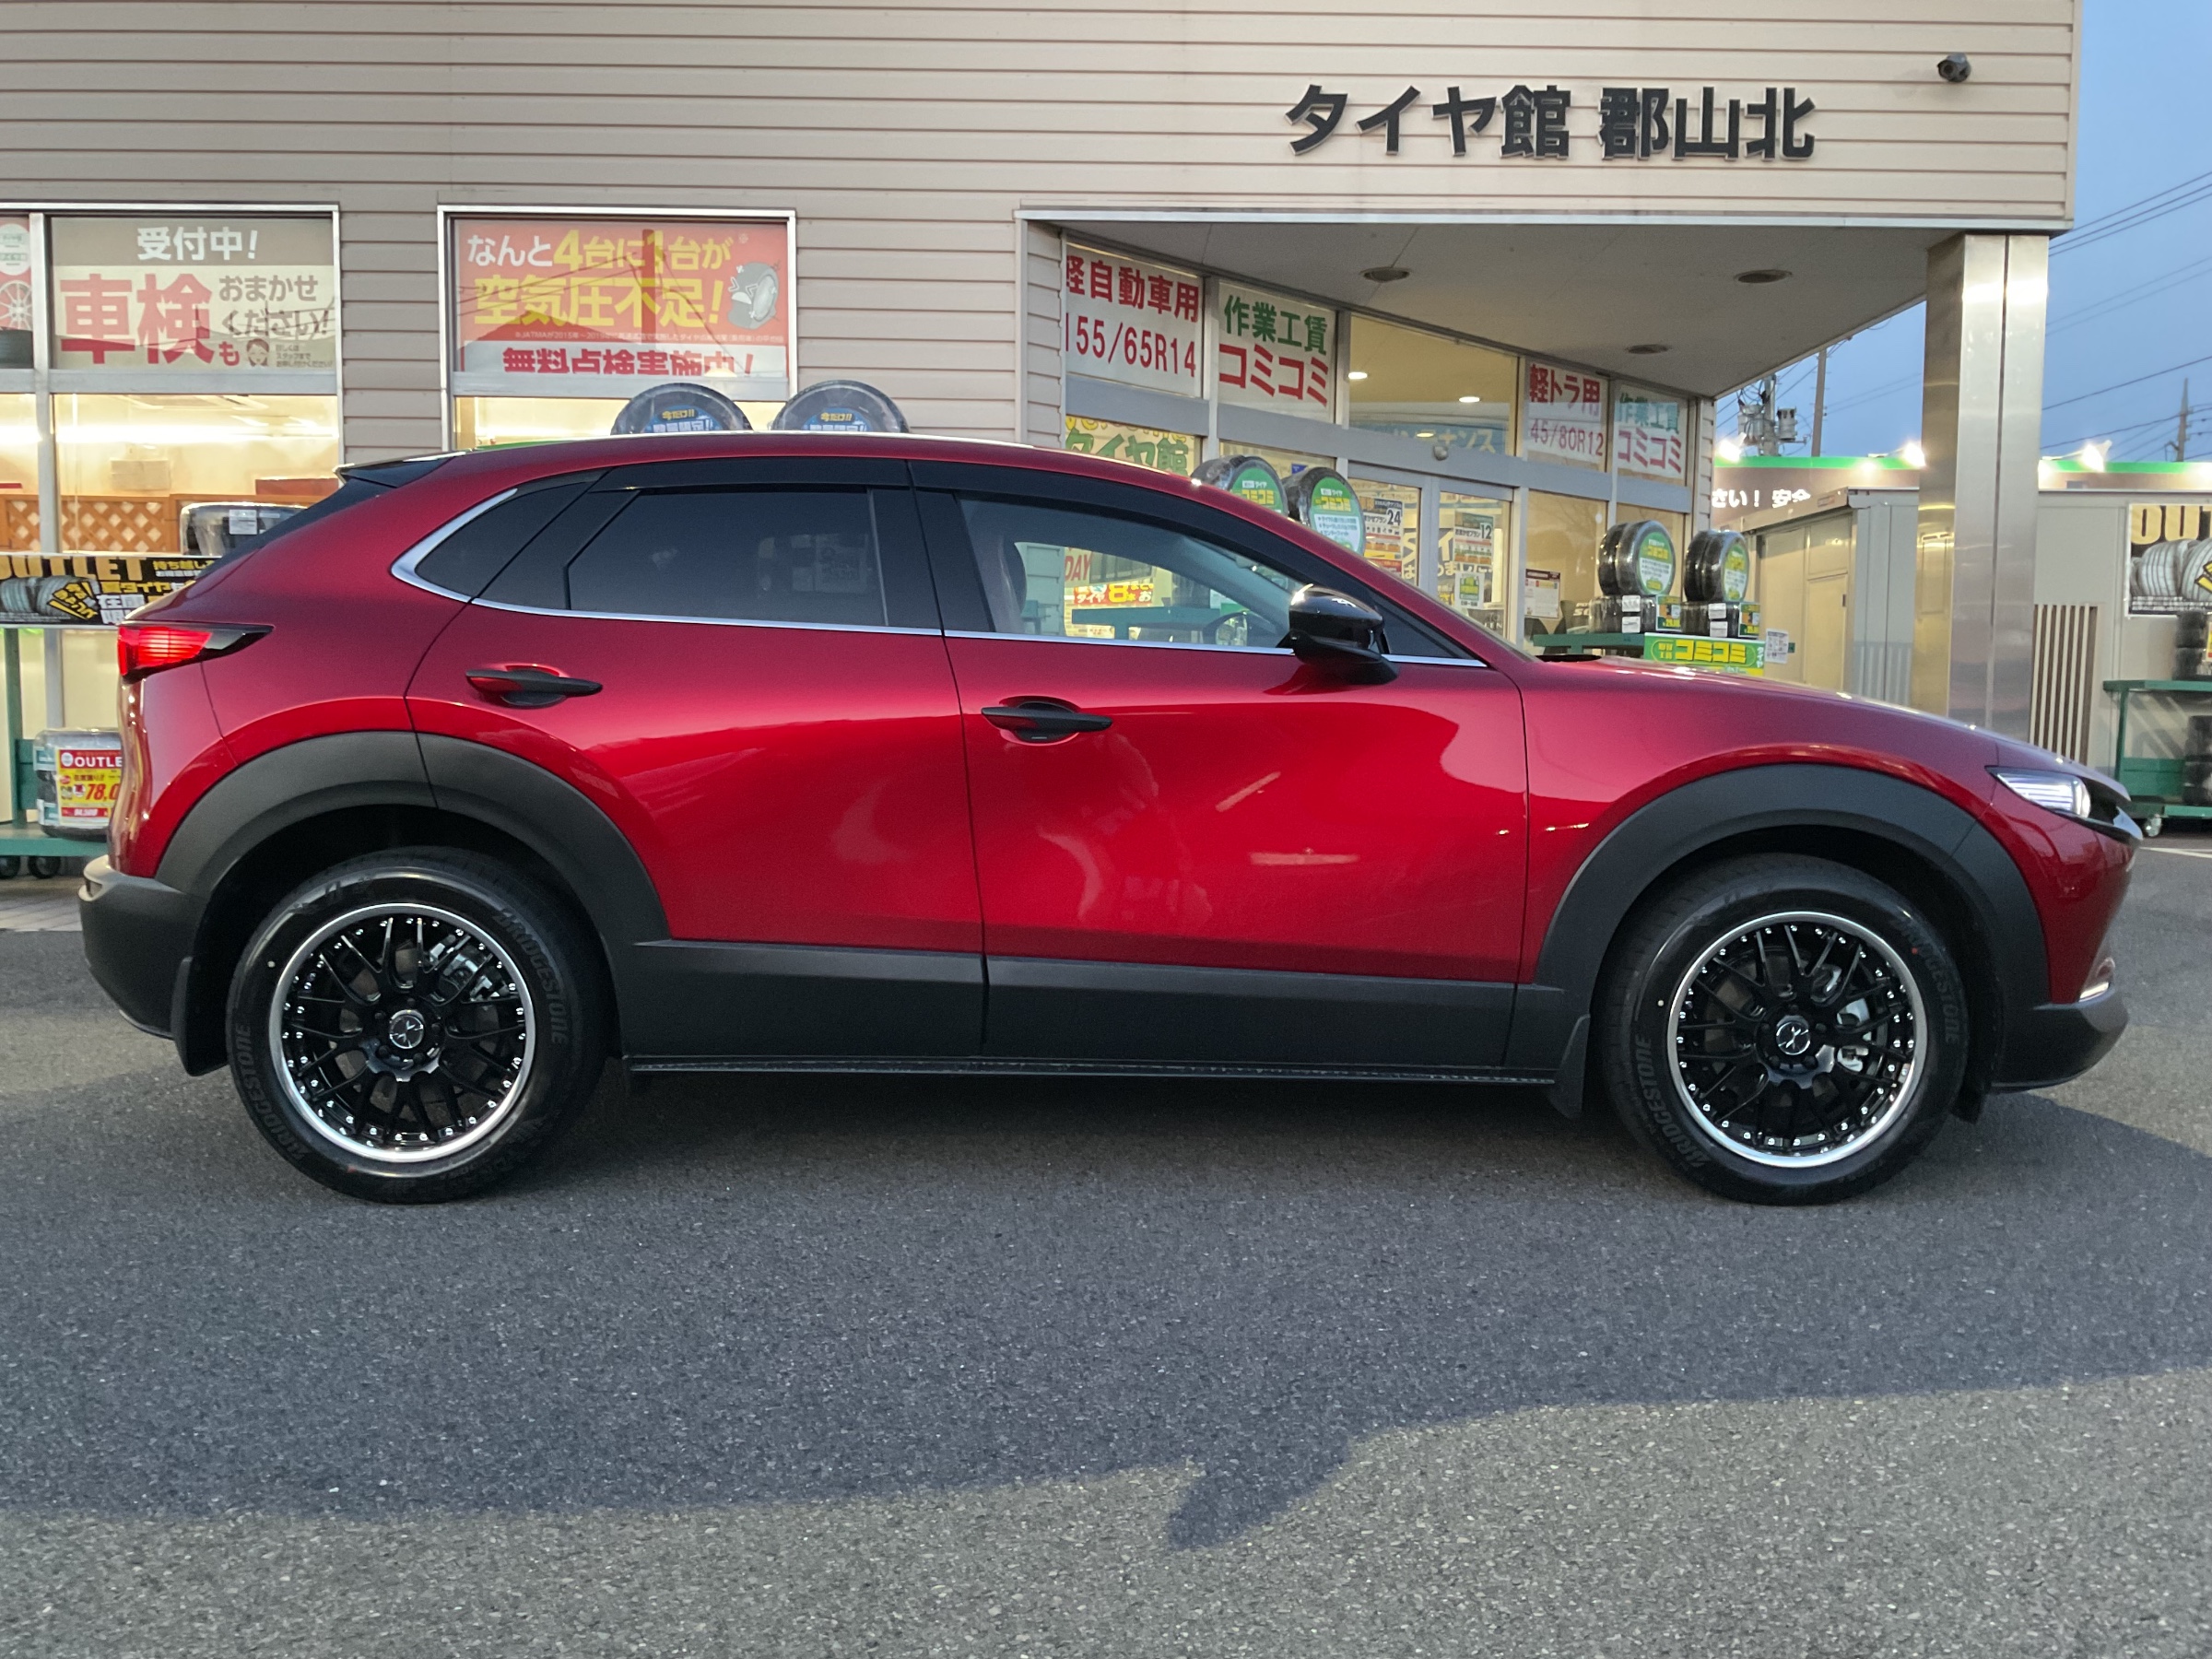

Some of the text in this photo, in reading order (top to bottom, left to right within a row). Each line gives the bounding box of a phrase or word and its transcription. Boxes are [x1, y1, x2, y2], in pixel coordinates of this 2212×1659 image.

[1284, 84, 1816, 160] タイヤ館 郡山北
[219, 275, 318, 301] おまかせ
[1224, 295, 1328, 357] 作業工賃
[1219, 342, 1329, 408] コミコミ
[1529, 363, 1601, 418] 軽トラ用
[1618, 427, 1682, 475] コミコミ
[1386, 509, 1402, 527] 24
[1480, 524, 1492, 540] 12
[1676, 639, 1747, 664] コミコミ
[1635, 1033, 1712, 1169] BRIDGESTONE
